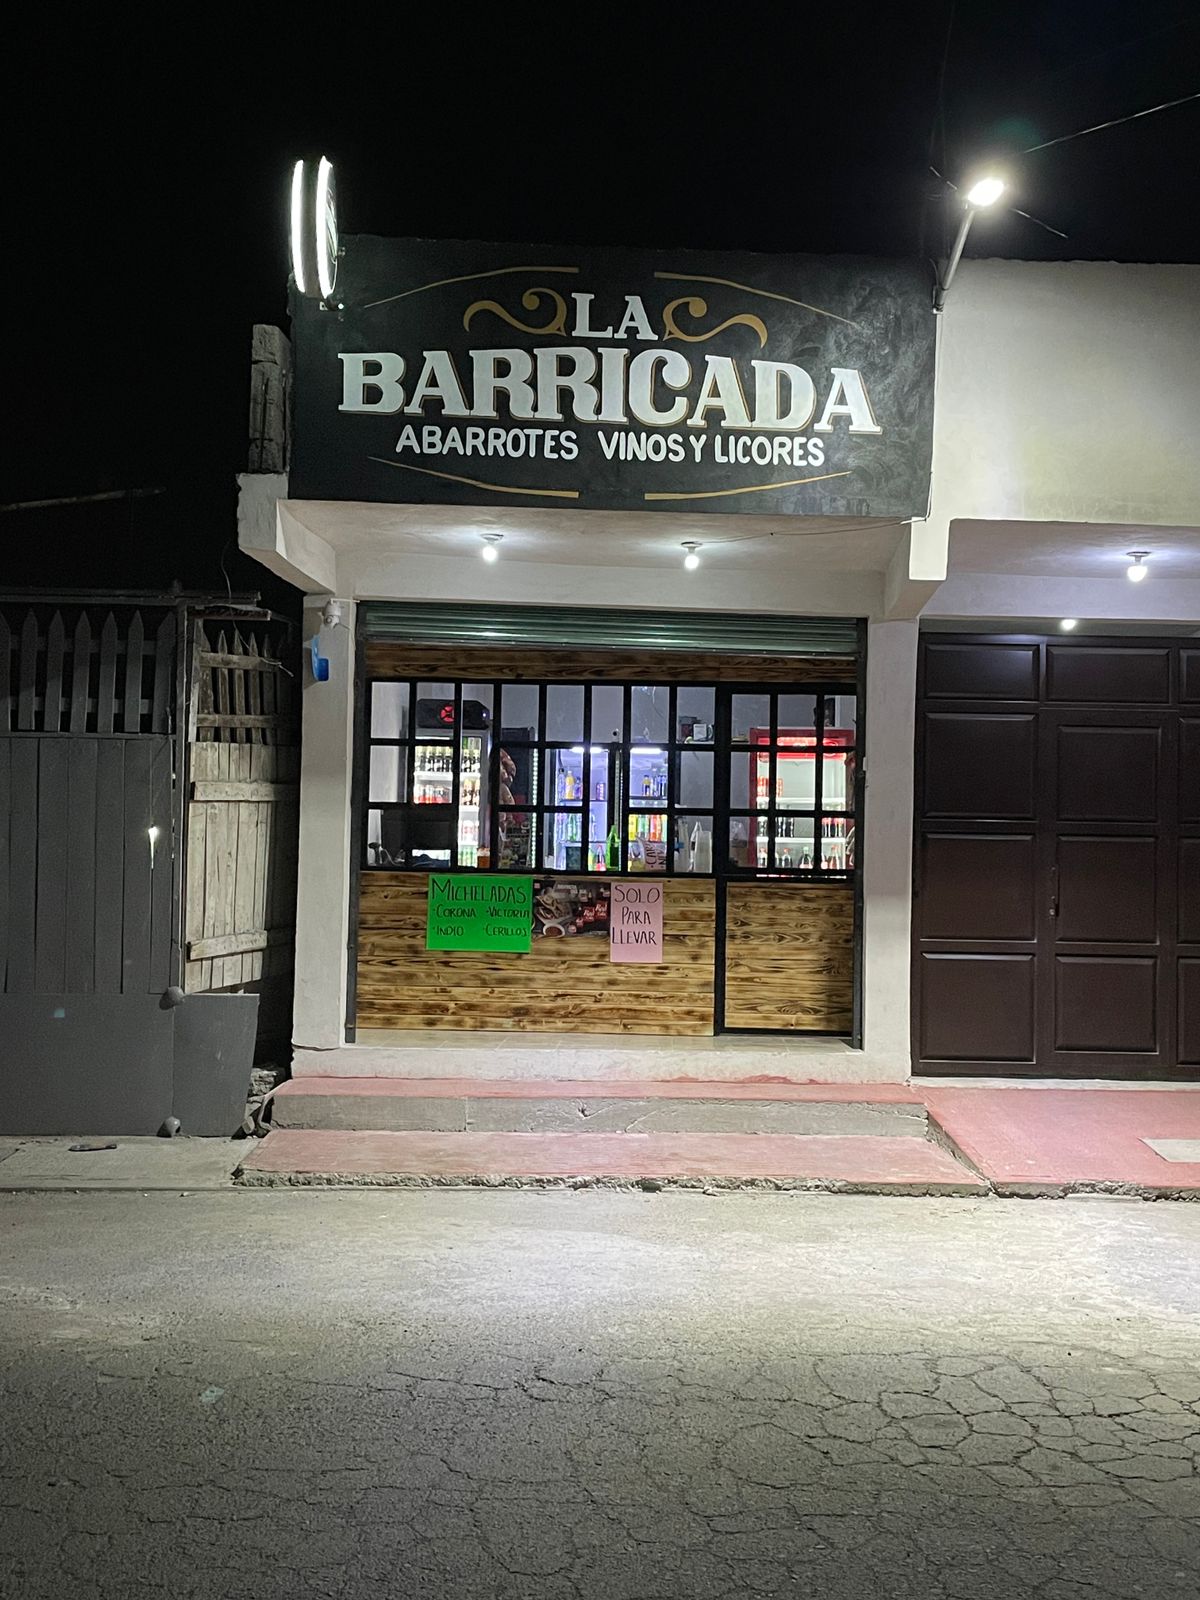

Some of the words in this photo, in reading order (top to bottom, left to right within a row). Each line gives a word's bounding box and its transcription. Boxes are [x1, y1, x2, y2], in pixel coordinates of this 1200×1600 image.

[570, 291, 659, 342] LA
[336, 345, 885, 436] BARRICADA
[395, 424, 580, 461] ABARROTES
[597, 430, 686, 463] VINOS
[688, 433, 707, 464] Y
[713, 434, 826, 468] LICORES
[431, 878, 527, 904] MICHELADAS
[614, 884, 660, 904] SOLO
[436, 903, 477, 918] CORONA
[488, 906, 530, 918] VICTORIA
[621, 906, 651, 925] PARA
[436, 925, 464, 937] INDIO
[611, 927, 657, 945] LLEVAR
